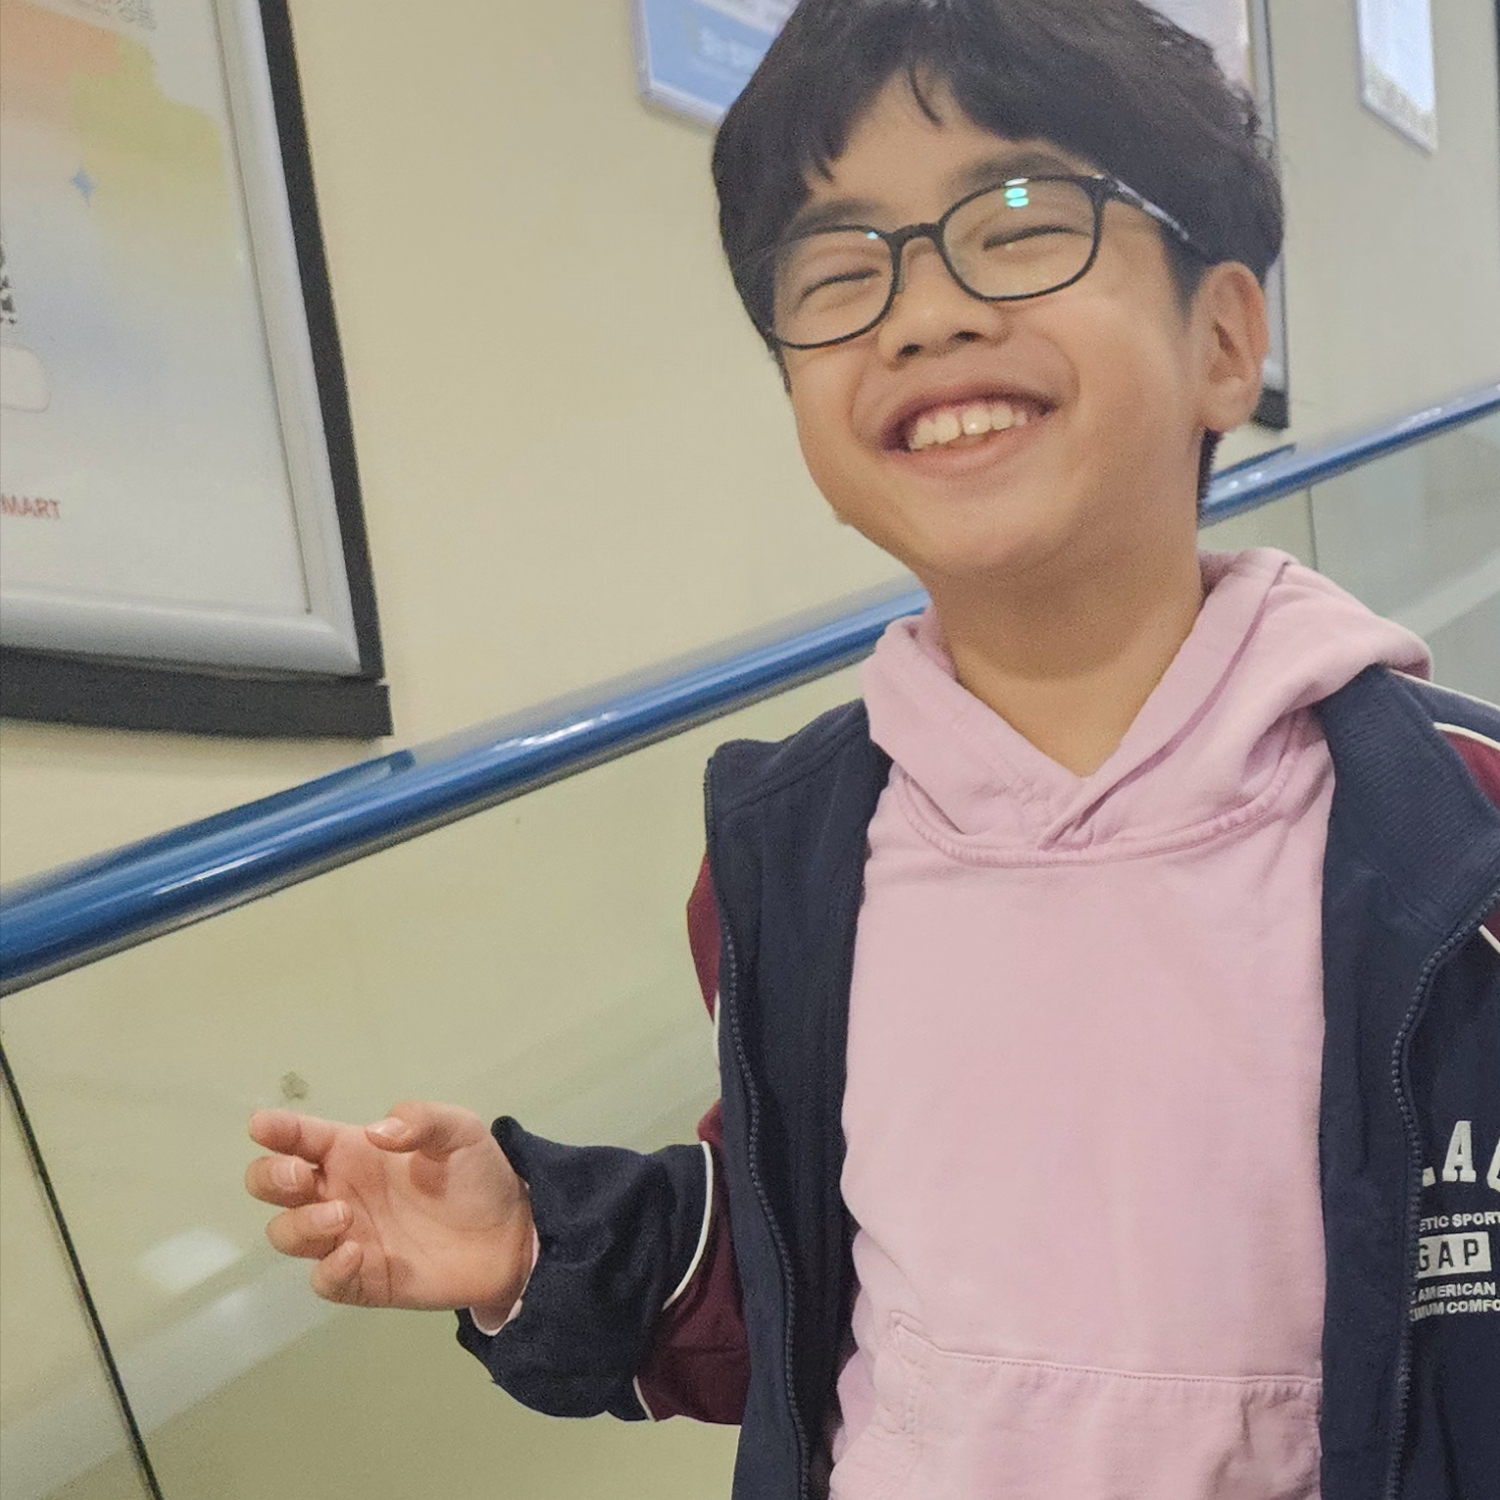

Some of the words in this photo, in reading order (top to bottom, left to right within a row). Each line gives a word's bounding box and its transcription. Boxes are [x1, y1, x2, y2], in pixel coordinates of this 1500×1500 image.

[0, 493, 61, 520] MART
[1418, 1238, 1480, 1272] GAP
[1418, 1281, 1496, 1302] AMERICAN
